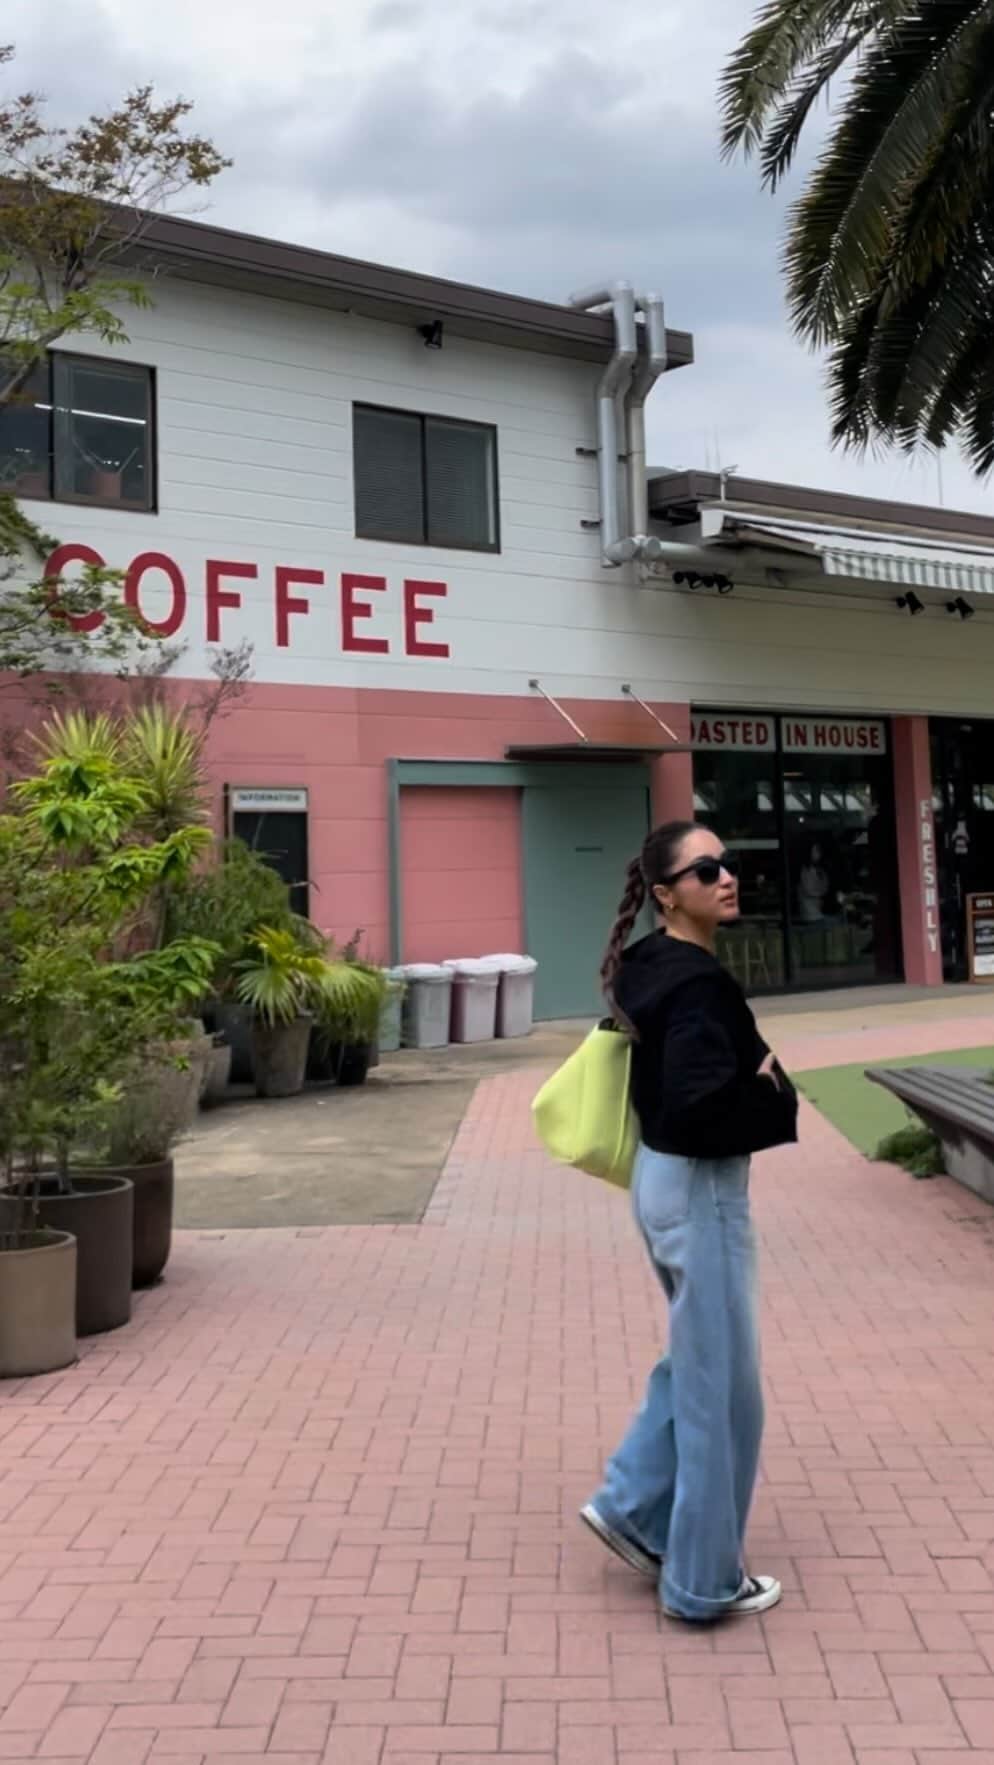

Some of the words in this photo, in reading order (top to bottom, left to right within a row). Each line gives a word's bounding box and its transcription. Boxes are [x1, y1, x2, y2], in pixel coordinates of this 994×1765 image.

[43, 543, 450, 658] COFFEE
[690, 719, 769, 746] ASTED
[786, 723, 808, 747] IN
[813, 724, 880, 749] HOUSE
[919, 801, 937, 952] FRESHLY
